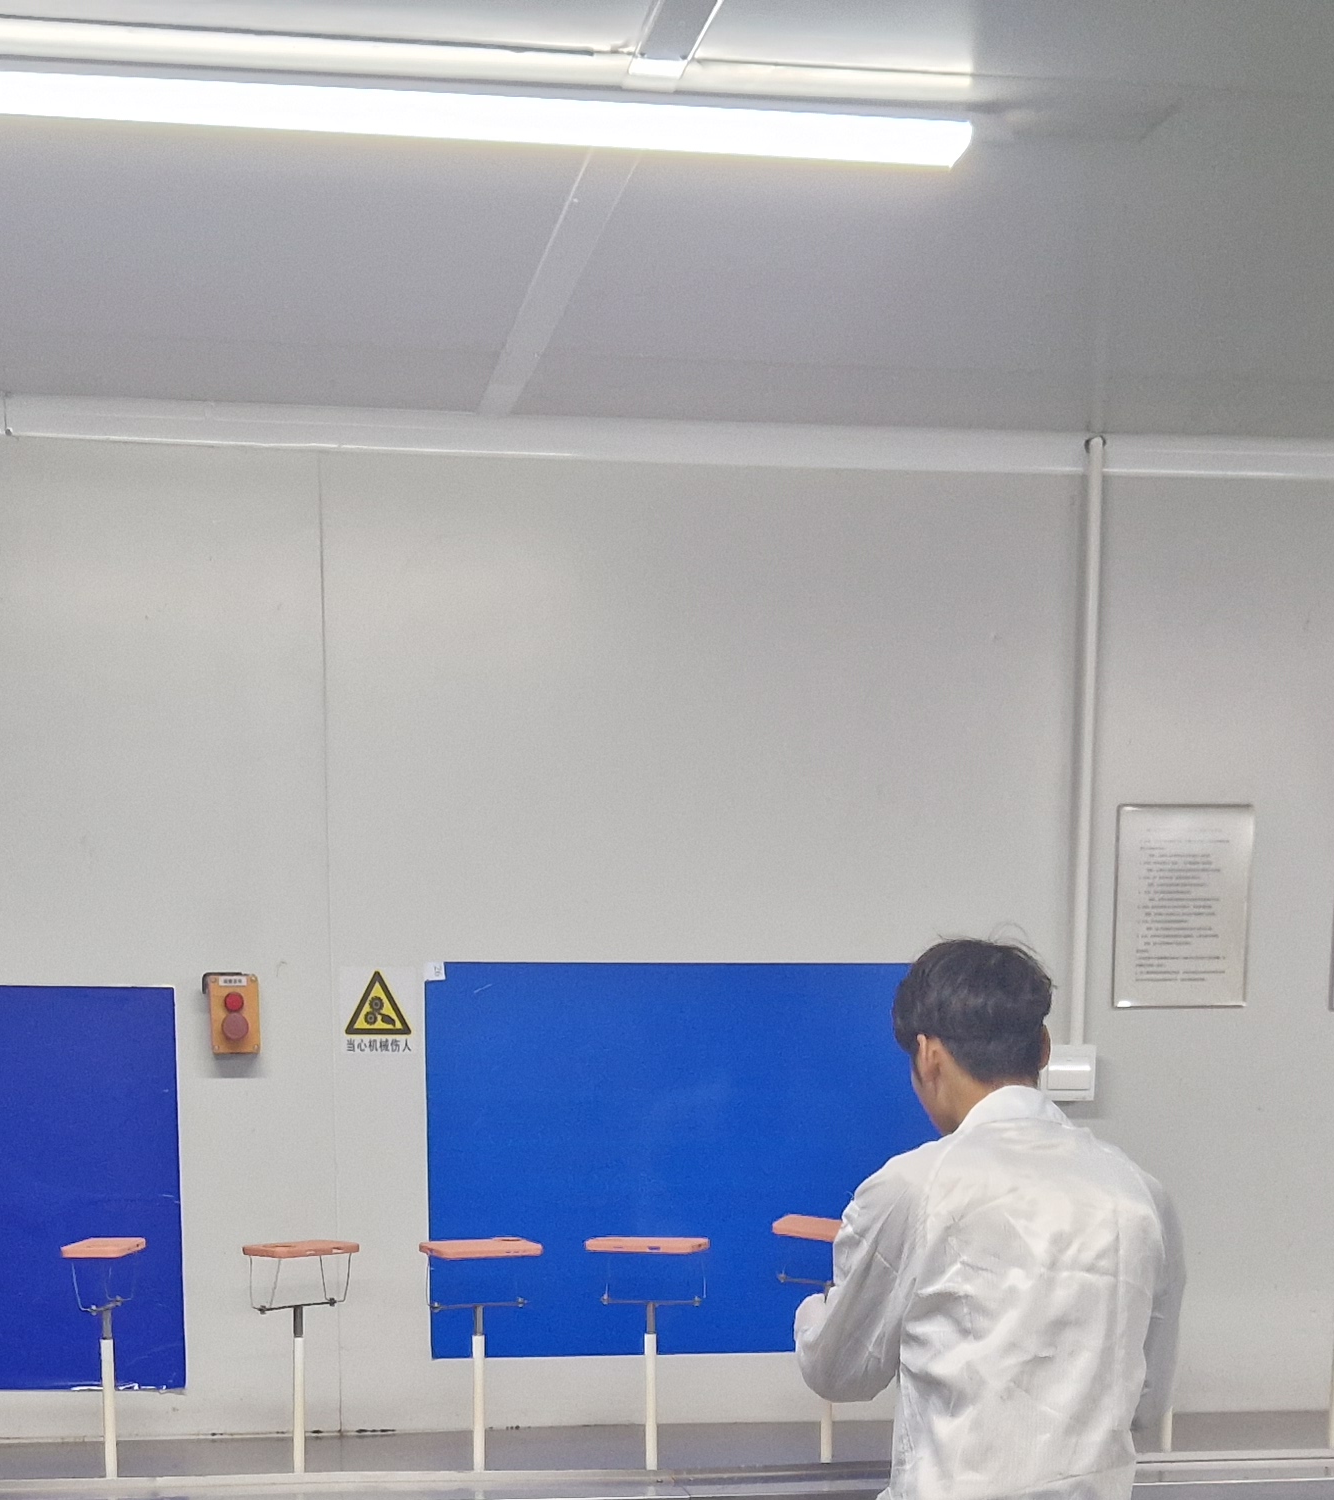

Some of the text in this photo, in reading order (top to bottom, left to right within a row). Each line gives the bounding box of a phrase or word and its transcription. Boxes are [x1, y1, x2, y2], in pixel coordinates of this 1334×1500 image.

[346, 1038, 412, 1053] 当心机械伤人
